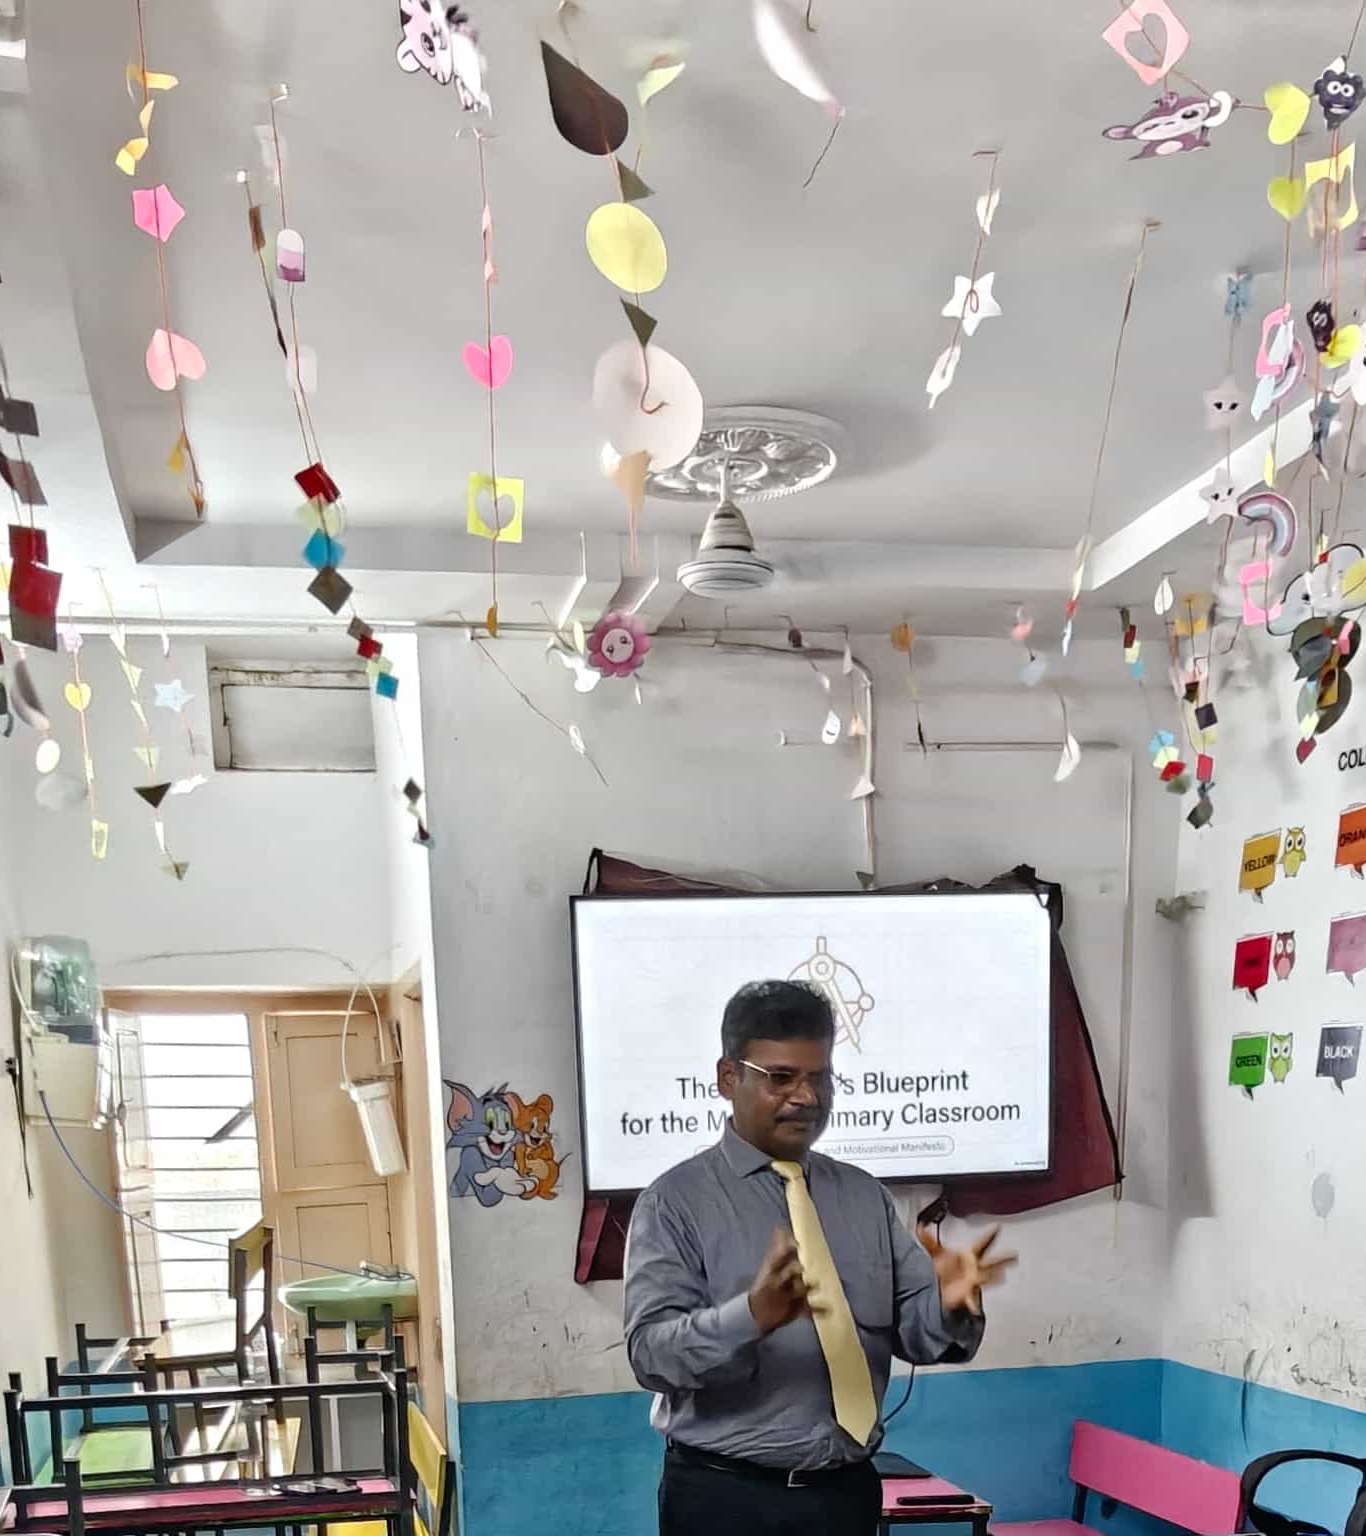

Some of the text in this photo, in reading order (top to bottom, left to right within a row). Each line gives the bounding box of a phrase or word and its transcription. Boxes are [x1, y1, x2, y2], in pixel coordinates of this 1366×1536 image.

[1244, 853, 1276, 873] YELLOW
[1234, 1053, 1263, 1069] GREEN
[1323, 1045, 1355, 1061] BLACK
[675, 1076, 719, 1100] The
[863, 1068, 970, 1098] Blueprint
[621, 1112, 653, 1136] for
[660, 1110, 699, 1133] the
[830, 1108, 894, 1132] imary
[900, 1102, 1021, 1126] Classroom
[842, 1141, 899, 1154] Motivational
